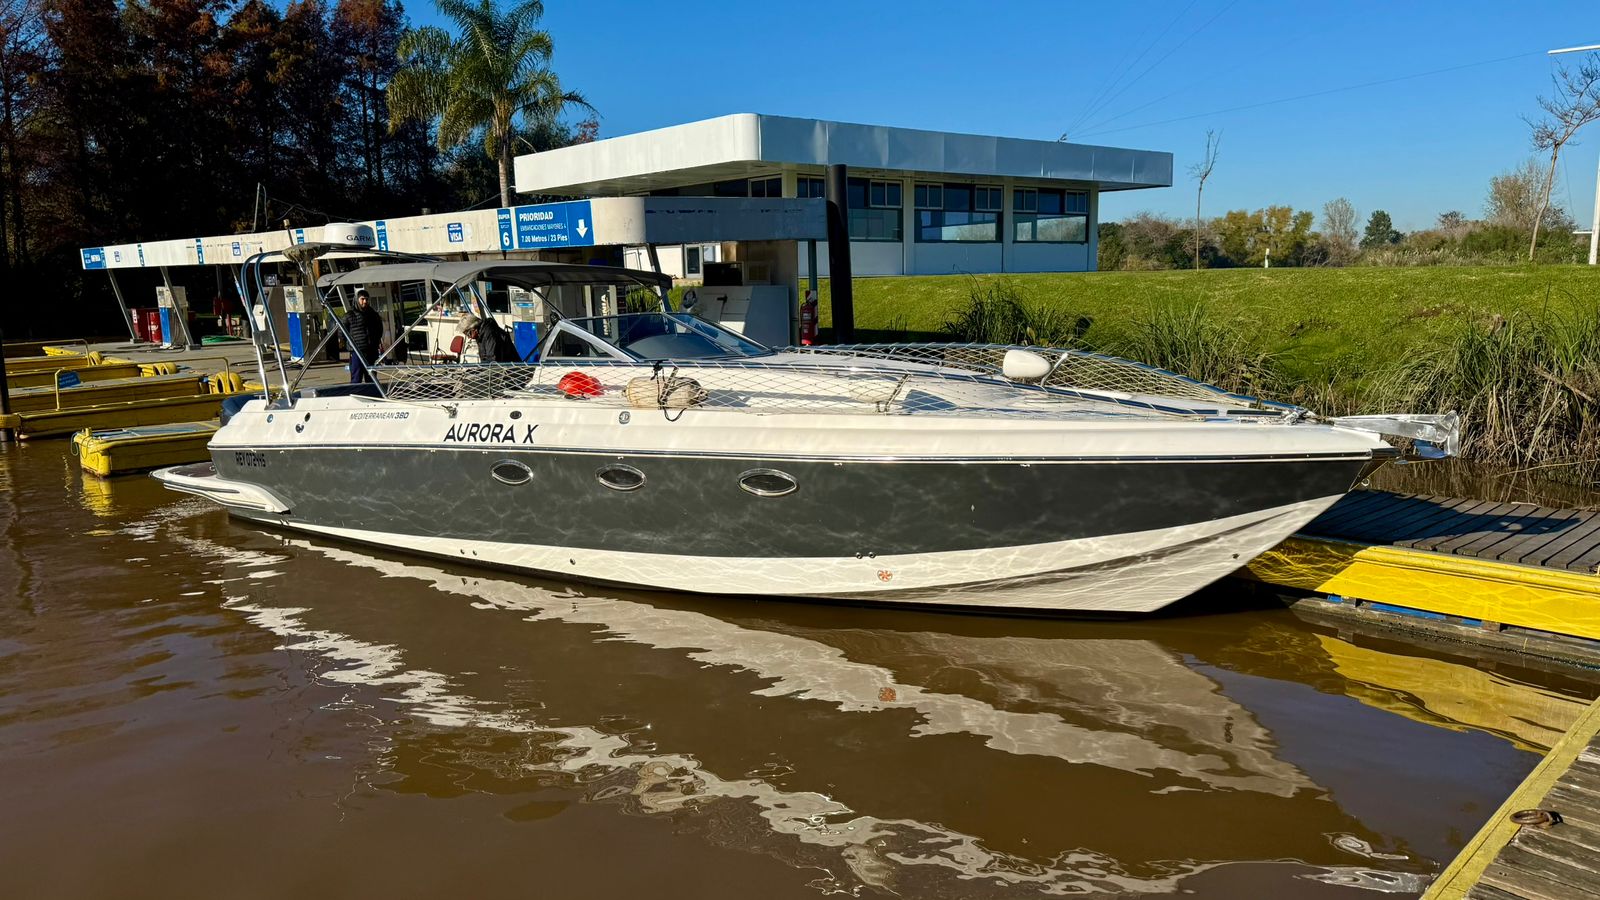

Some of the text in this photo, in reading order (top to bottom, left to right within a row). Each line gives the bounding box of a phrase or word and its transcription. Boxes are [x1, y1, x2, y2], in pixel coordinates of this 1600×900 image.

[519, 211, 553, 222] PRIORIDAD
[346, 234, 375, 242] GARM
[449, 232, 463, 242] VISA
[503, 232, 510, 246] 6
[521, 235, 531, 243] 7.00
[557, 233, 568, 242] Pies
[380, 240, 386, 251] 5
[349, 411, 410, 421] MEDITERRANEAN 380
[443, 423, 540, 444] AURORA X
